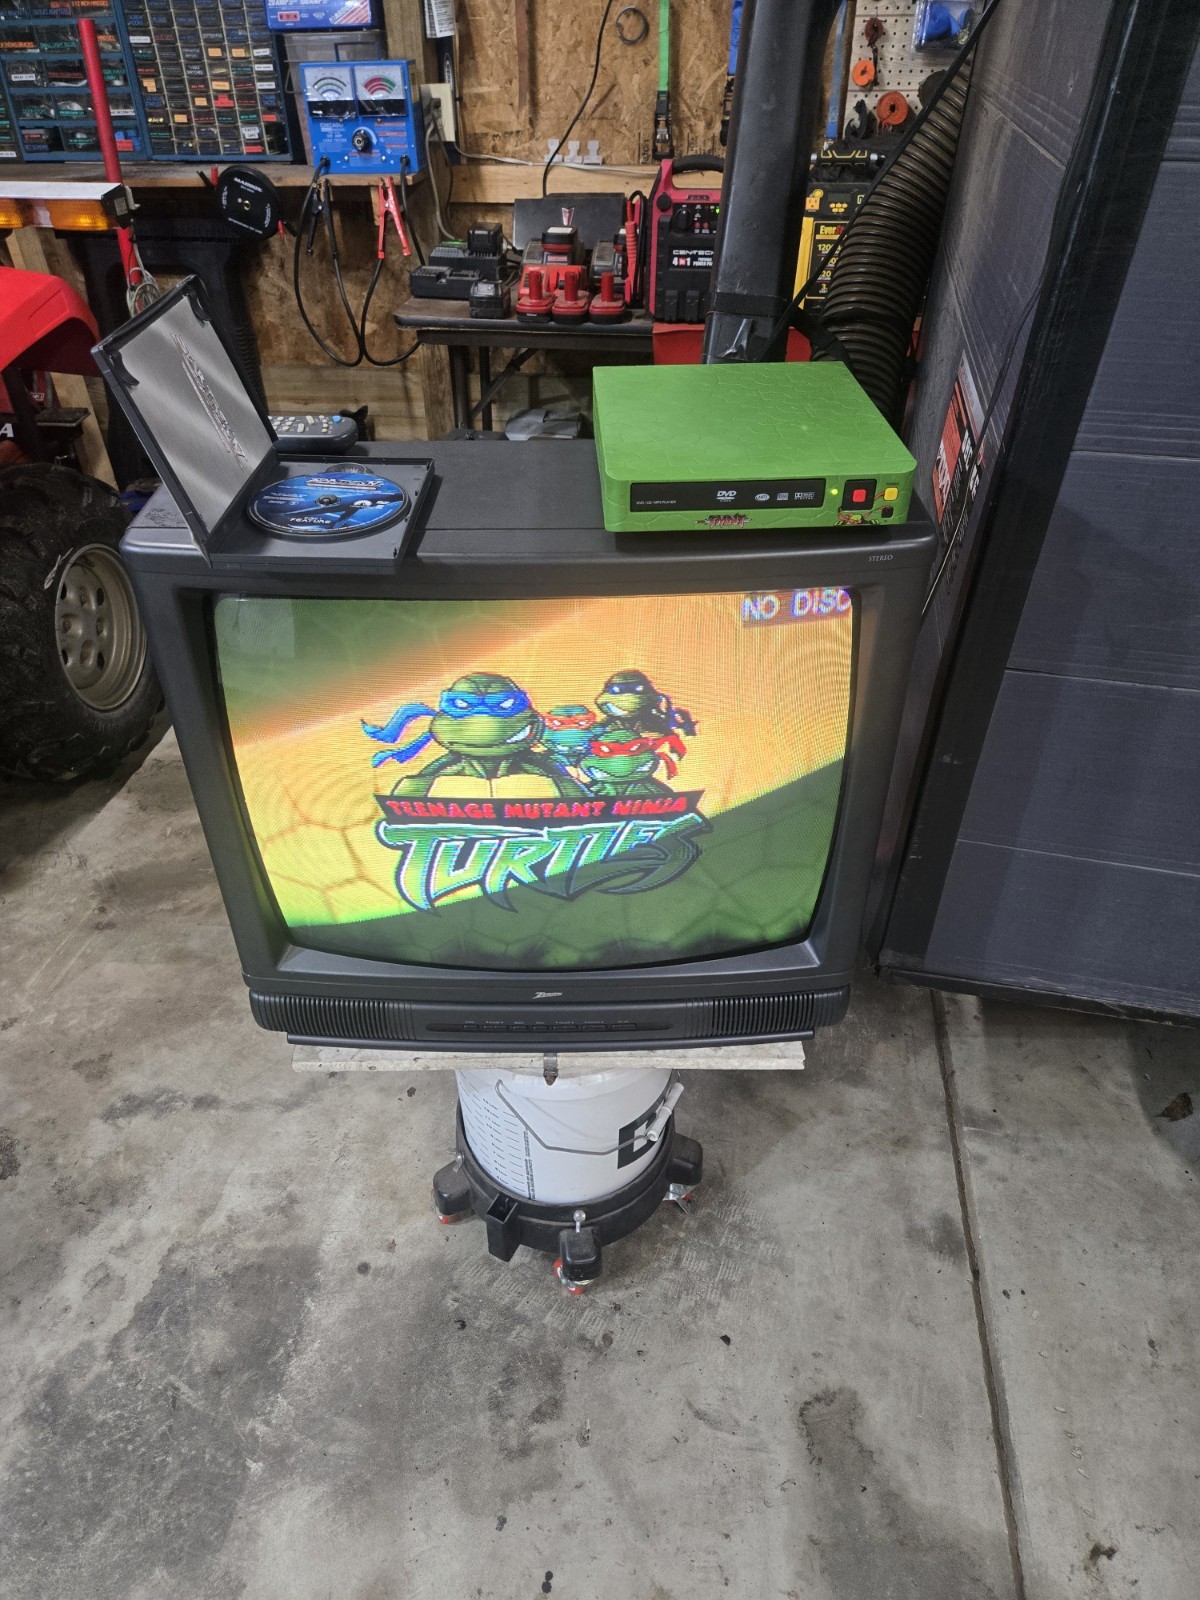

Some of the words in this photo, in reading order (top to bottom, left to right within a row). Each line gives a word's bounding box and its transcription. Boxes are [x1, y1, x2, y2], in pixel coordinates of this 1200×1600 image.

[716, 490, 737, 498] DVD
[742, 594, 781, 622] NO
[791, 588, 851, 616] DISC
[385, 800, 497, 819] TEENAGE
[503, 801, 606, 819] MUTANT
[611, 796, 688, 816] NINJA
